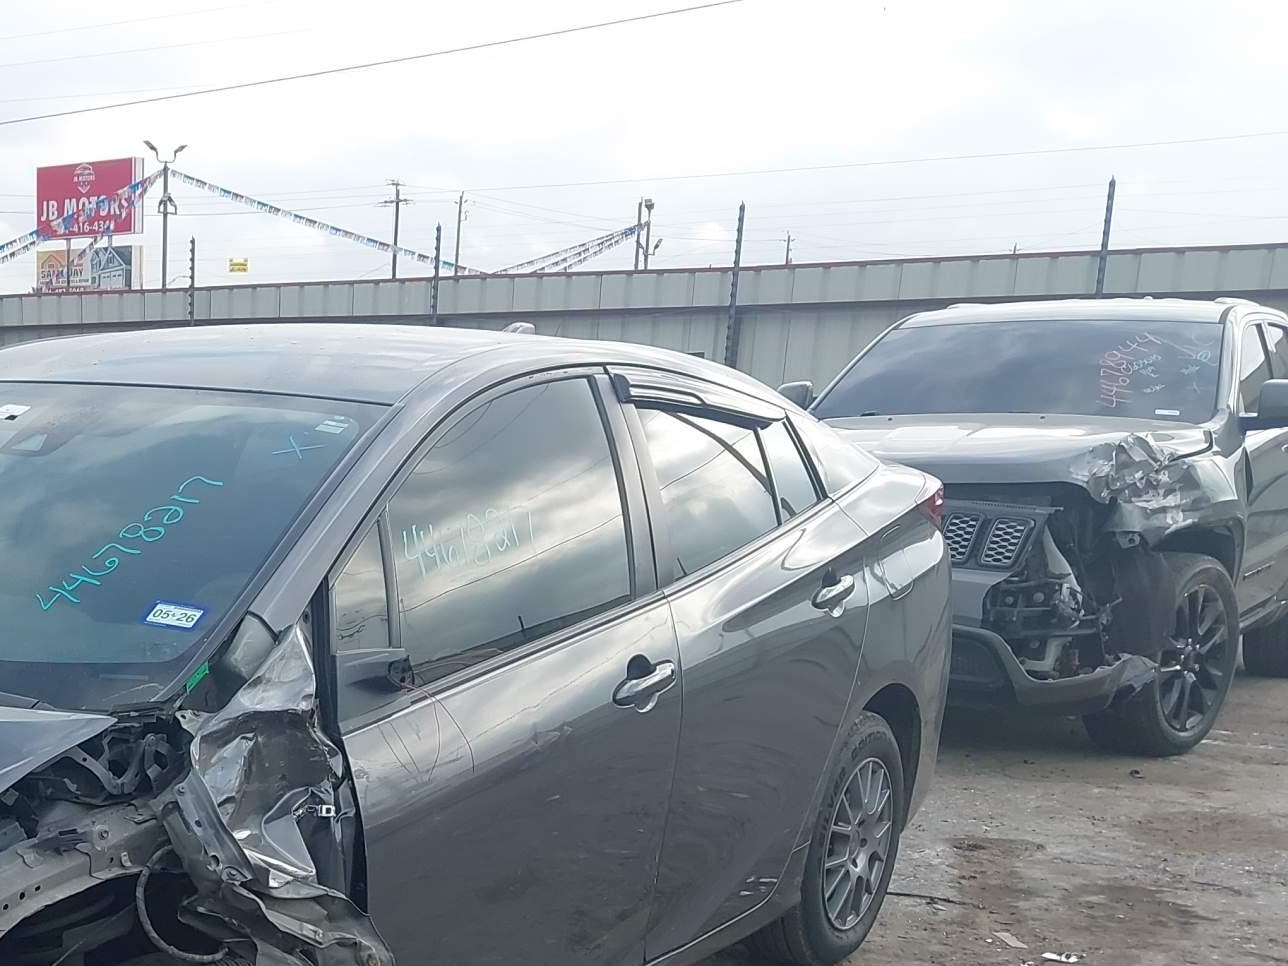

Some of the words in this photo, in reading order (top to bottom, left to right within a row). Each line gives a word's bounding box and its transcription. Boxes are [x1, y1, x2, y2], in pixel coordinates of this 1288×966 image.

[41, 200, 58, 222] JB
[64, 195, 129, 218] MOTORS
[36, 475, 224, 611] 44678217
[153, 609, 173, 619] 05
[176, 612, 197, 623] 26
